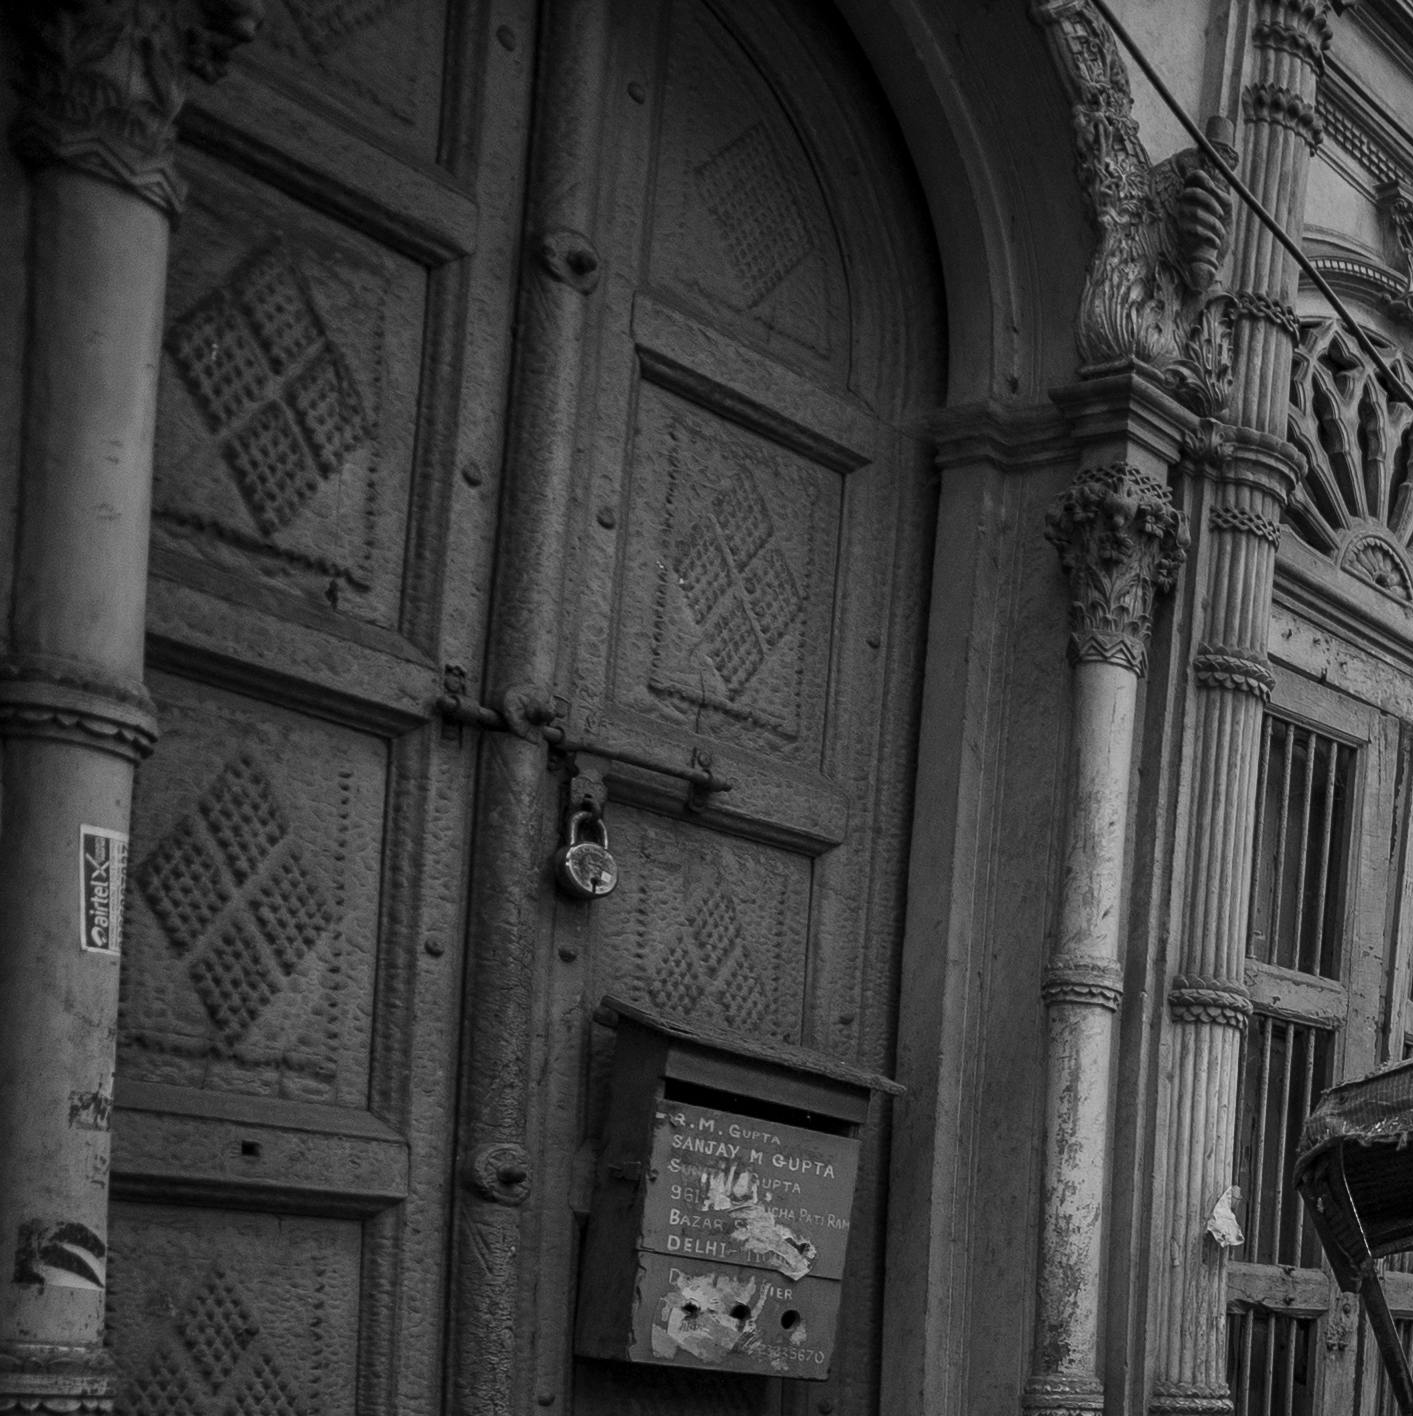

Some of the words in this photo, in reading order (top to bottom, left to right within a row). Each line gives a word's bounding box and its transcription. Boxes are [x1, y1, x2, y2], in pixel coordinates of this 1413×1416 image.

[88, 880, 110, 927] airtel
[728, 1123, 782, 1146] GUPTA
[671, 1133, 741, 1159] SANJAY
[749, 1149, 763, 1165] M
[771, 1153, 836, 1180] GUPTA
[668, 1207, 724, 1232] BAZAR
